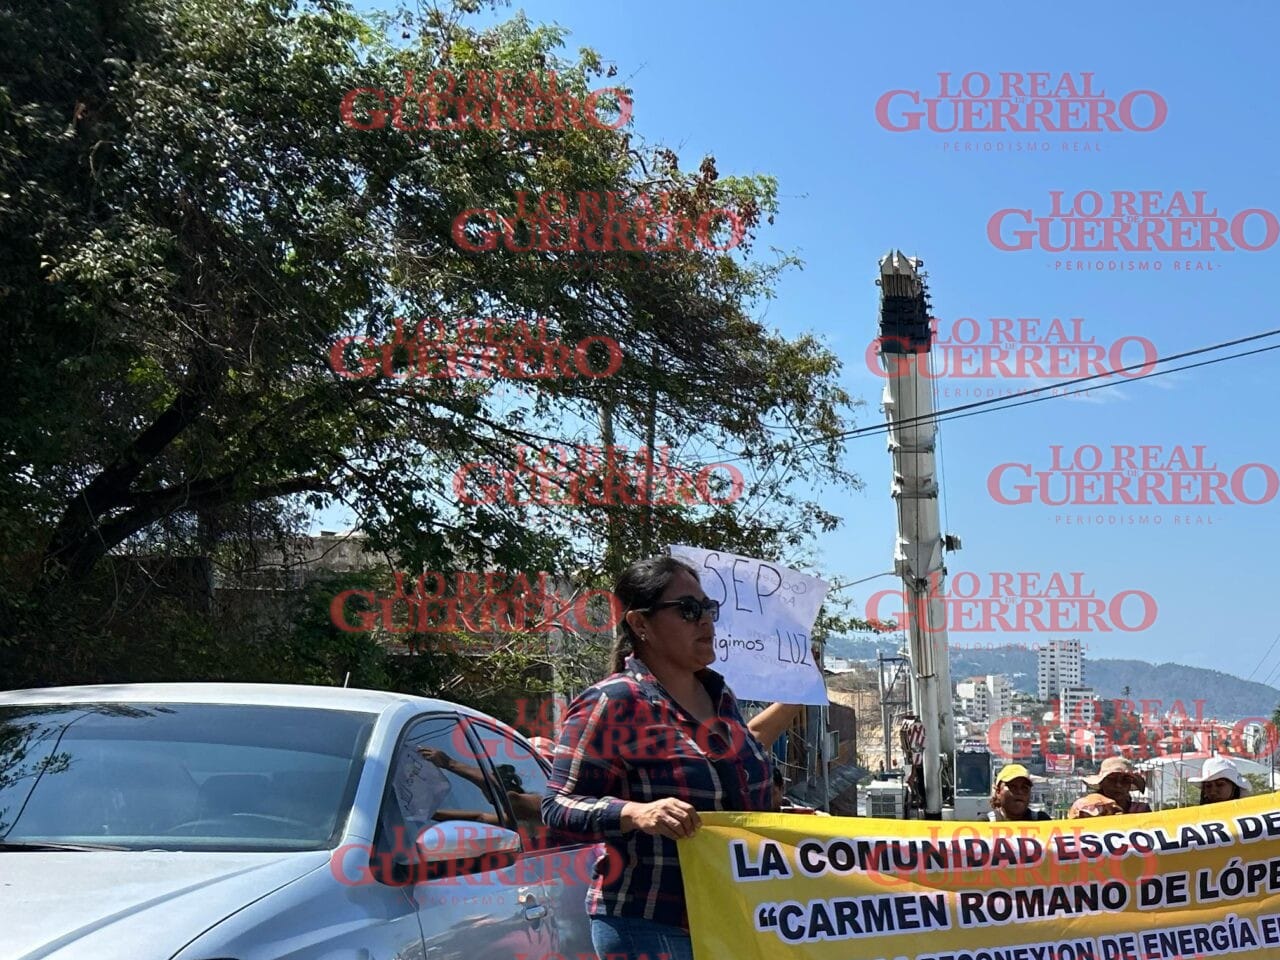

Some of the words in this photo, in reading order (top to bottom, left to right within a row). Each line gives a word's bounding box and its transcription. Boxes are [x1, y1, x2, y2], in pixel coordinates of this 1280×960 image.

[704, 552, 783, 615] SEP
[714, 634, 765, 662] igimos
[776, 628, 812, 667] LUZ
[734, 844, 789, 877] LA
[800, 838, 1042, 873] COMUNIDAD
[1055, 823, 1231, 861] ESCOLAR
[961, 882, 1127, 924] ROMANO
[1141, 874, 1187, 906] DE
[1143, 921, 1257, 957] ENERGÍA
